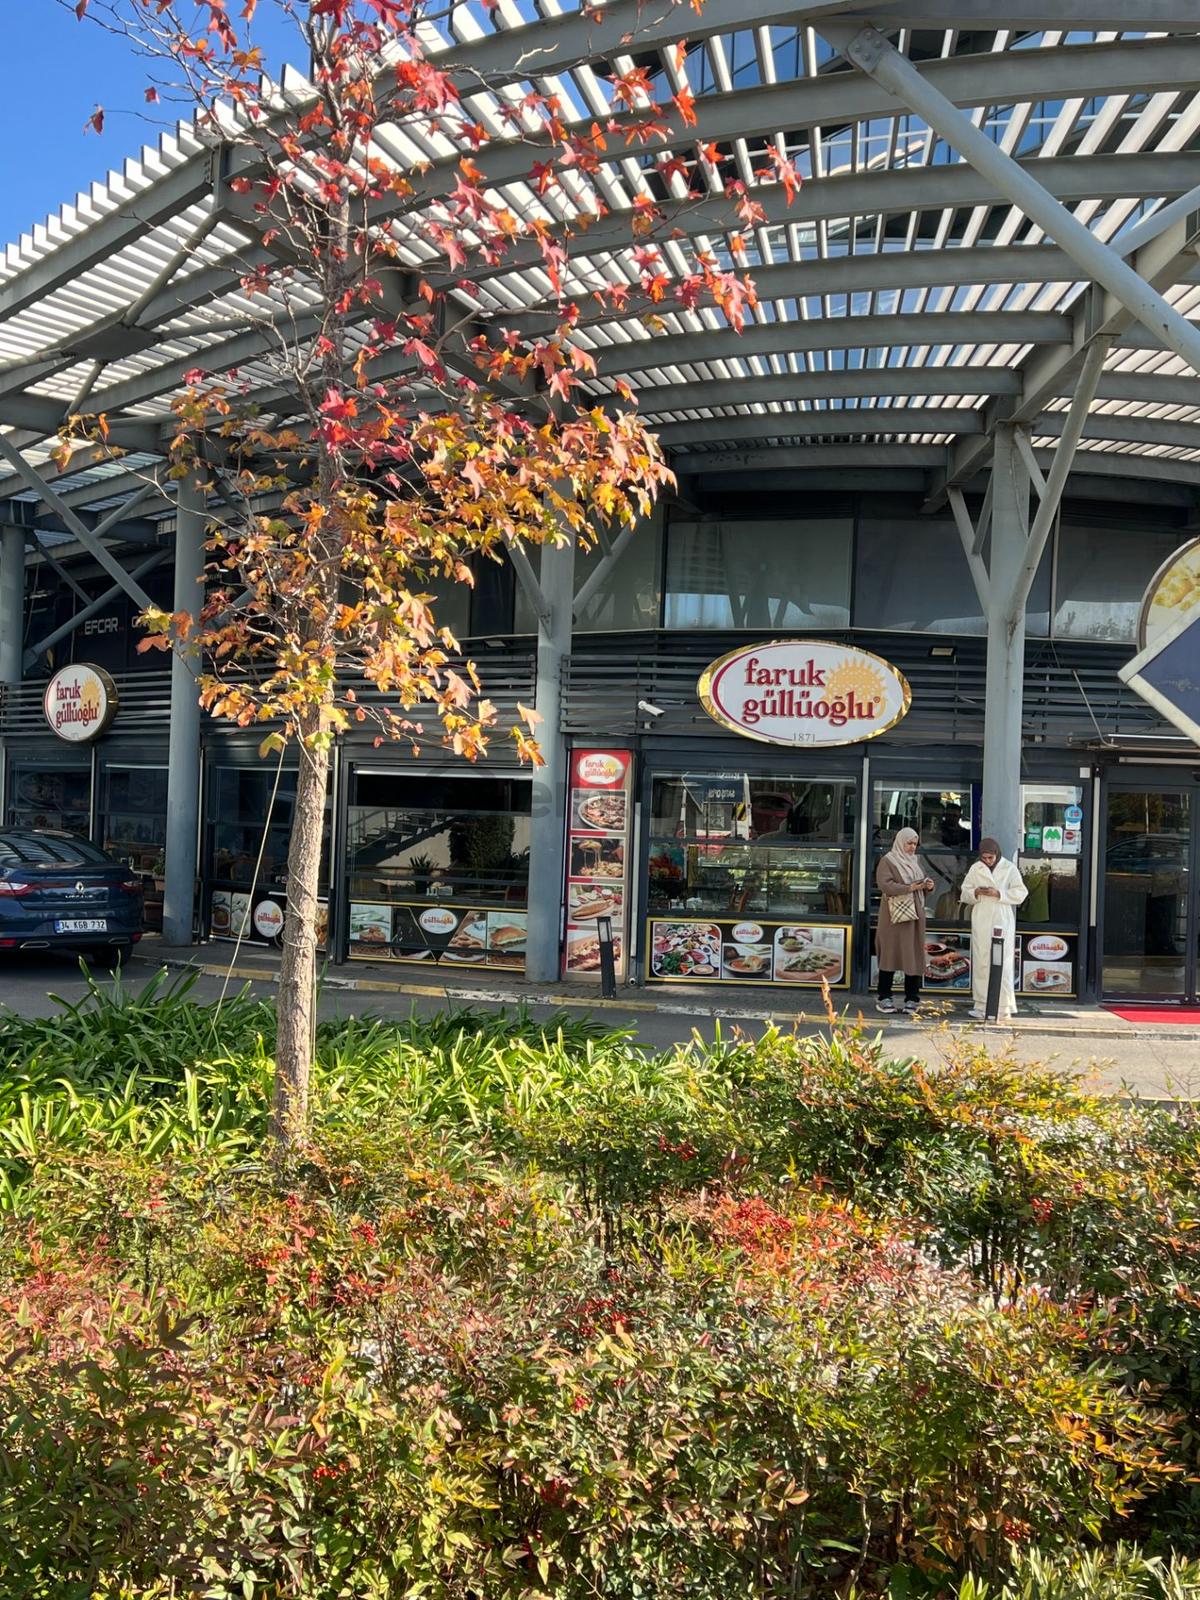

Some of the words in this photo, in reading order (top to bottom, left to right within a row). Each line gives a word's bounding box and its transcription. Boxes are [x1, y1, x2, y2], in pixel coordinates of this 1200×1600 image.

[84, 616, 118, 635] EFCAR
[744, 657, 826, 686] faruk
[56, 679, 81, 701] faruk
[741, 689, 875, 727] güllüoğlu
[792, 733, 816, 743] 1871
[90, 920, 105, 929] 732
